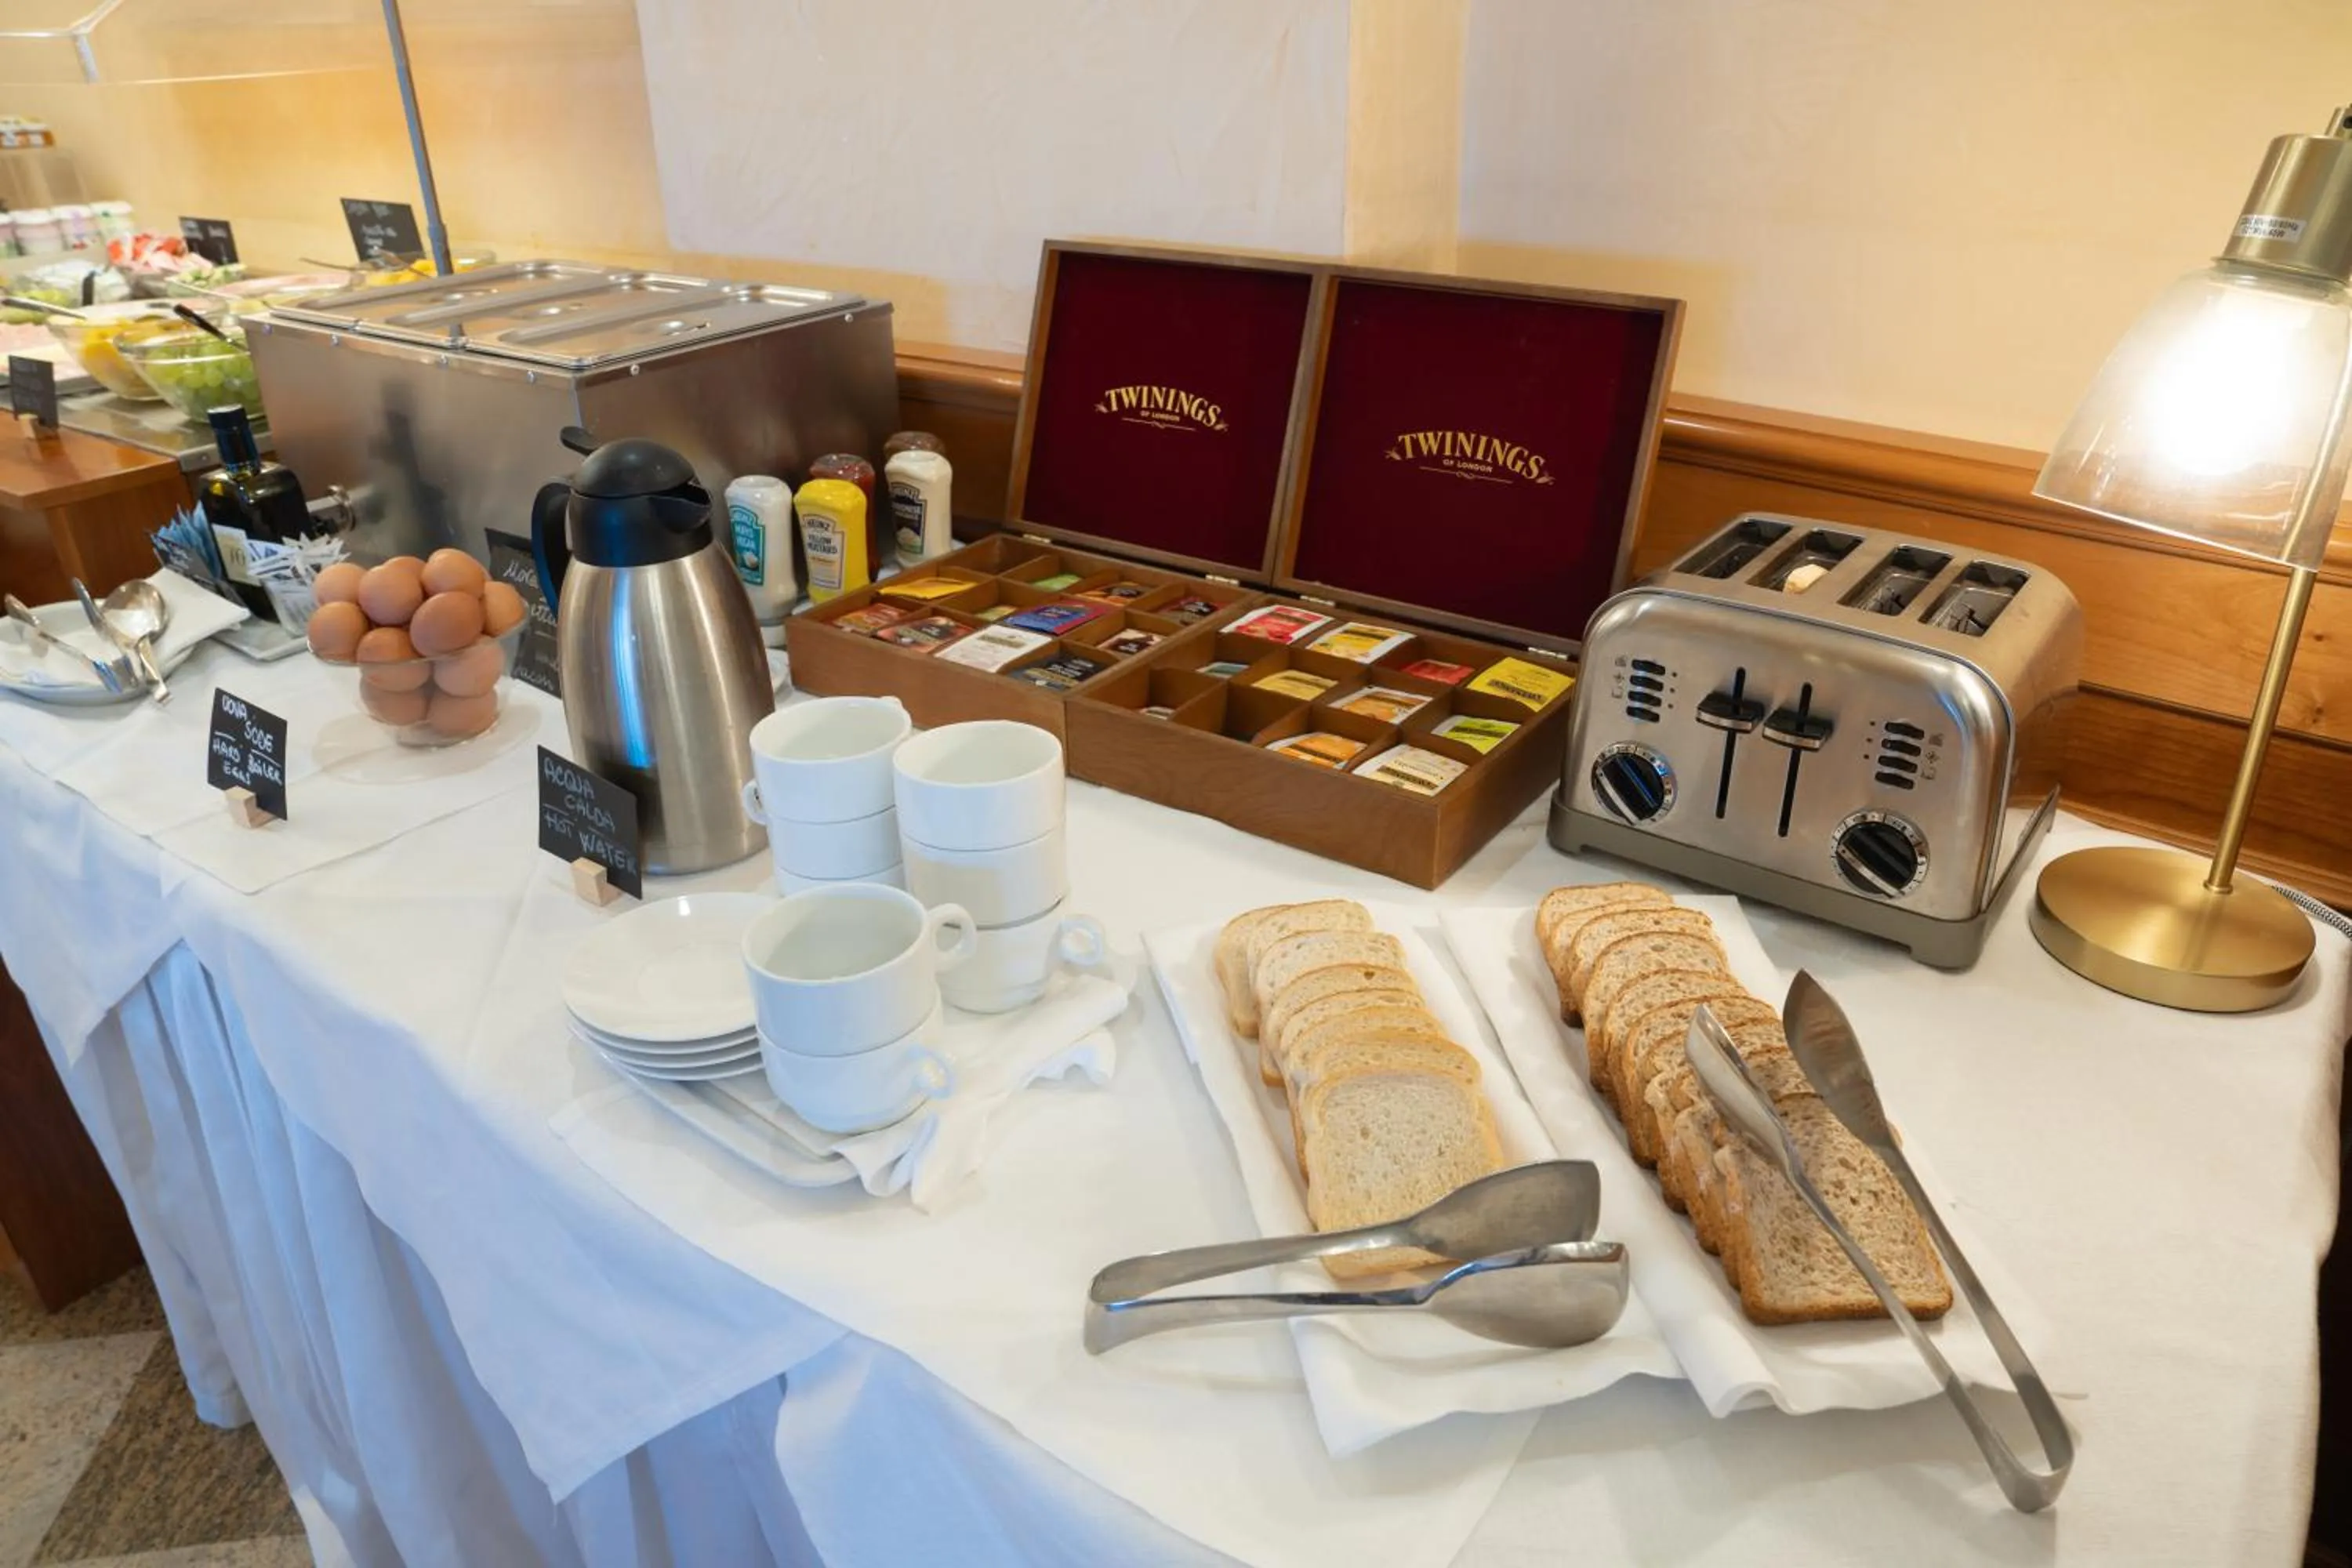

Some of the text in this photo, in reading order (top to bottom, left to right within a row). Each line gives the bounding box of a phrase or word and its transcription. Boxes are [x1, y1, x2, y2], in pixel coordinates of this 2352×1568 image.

[1105, 385, 1221, 426] TWININGS
[1398, 431, 1545, 480] TWININGS
[1457, 459, 1493, 472] LONDON
[543, 757, 594, 800] ACQUA
[564, 794, 615, 833] CALDA
[543, 811, 638, 876] HOT WATER
